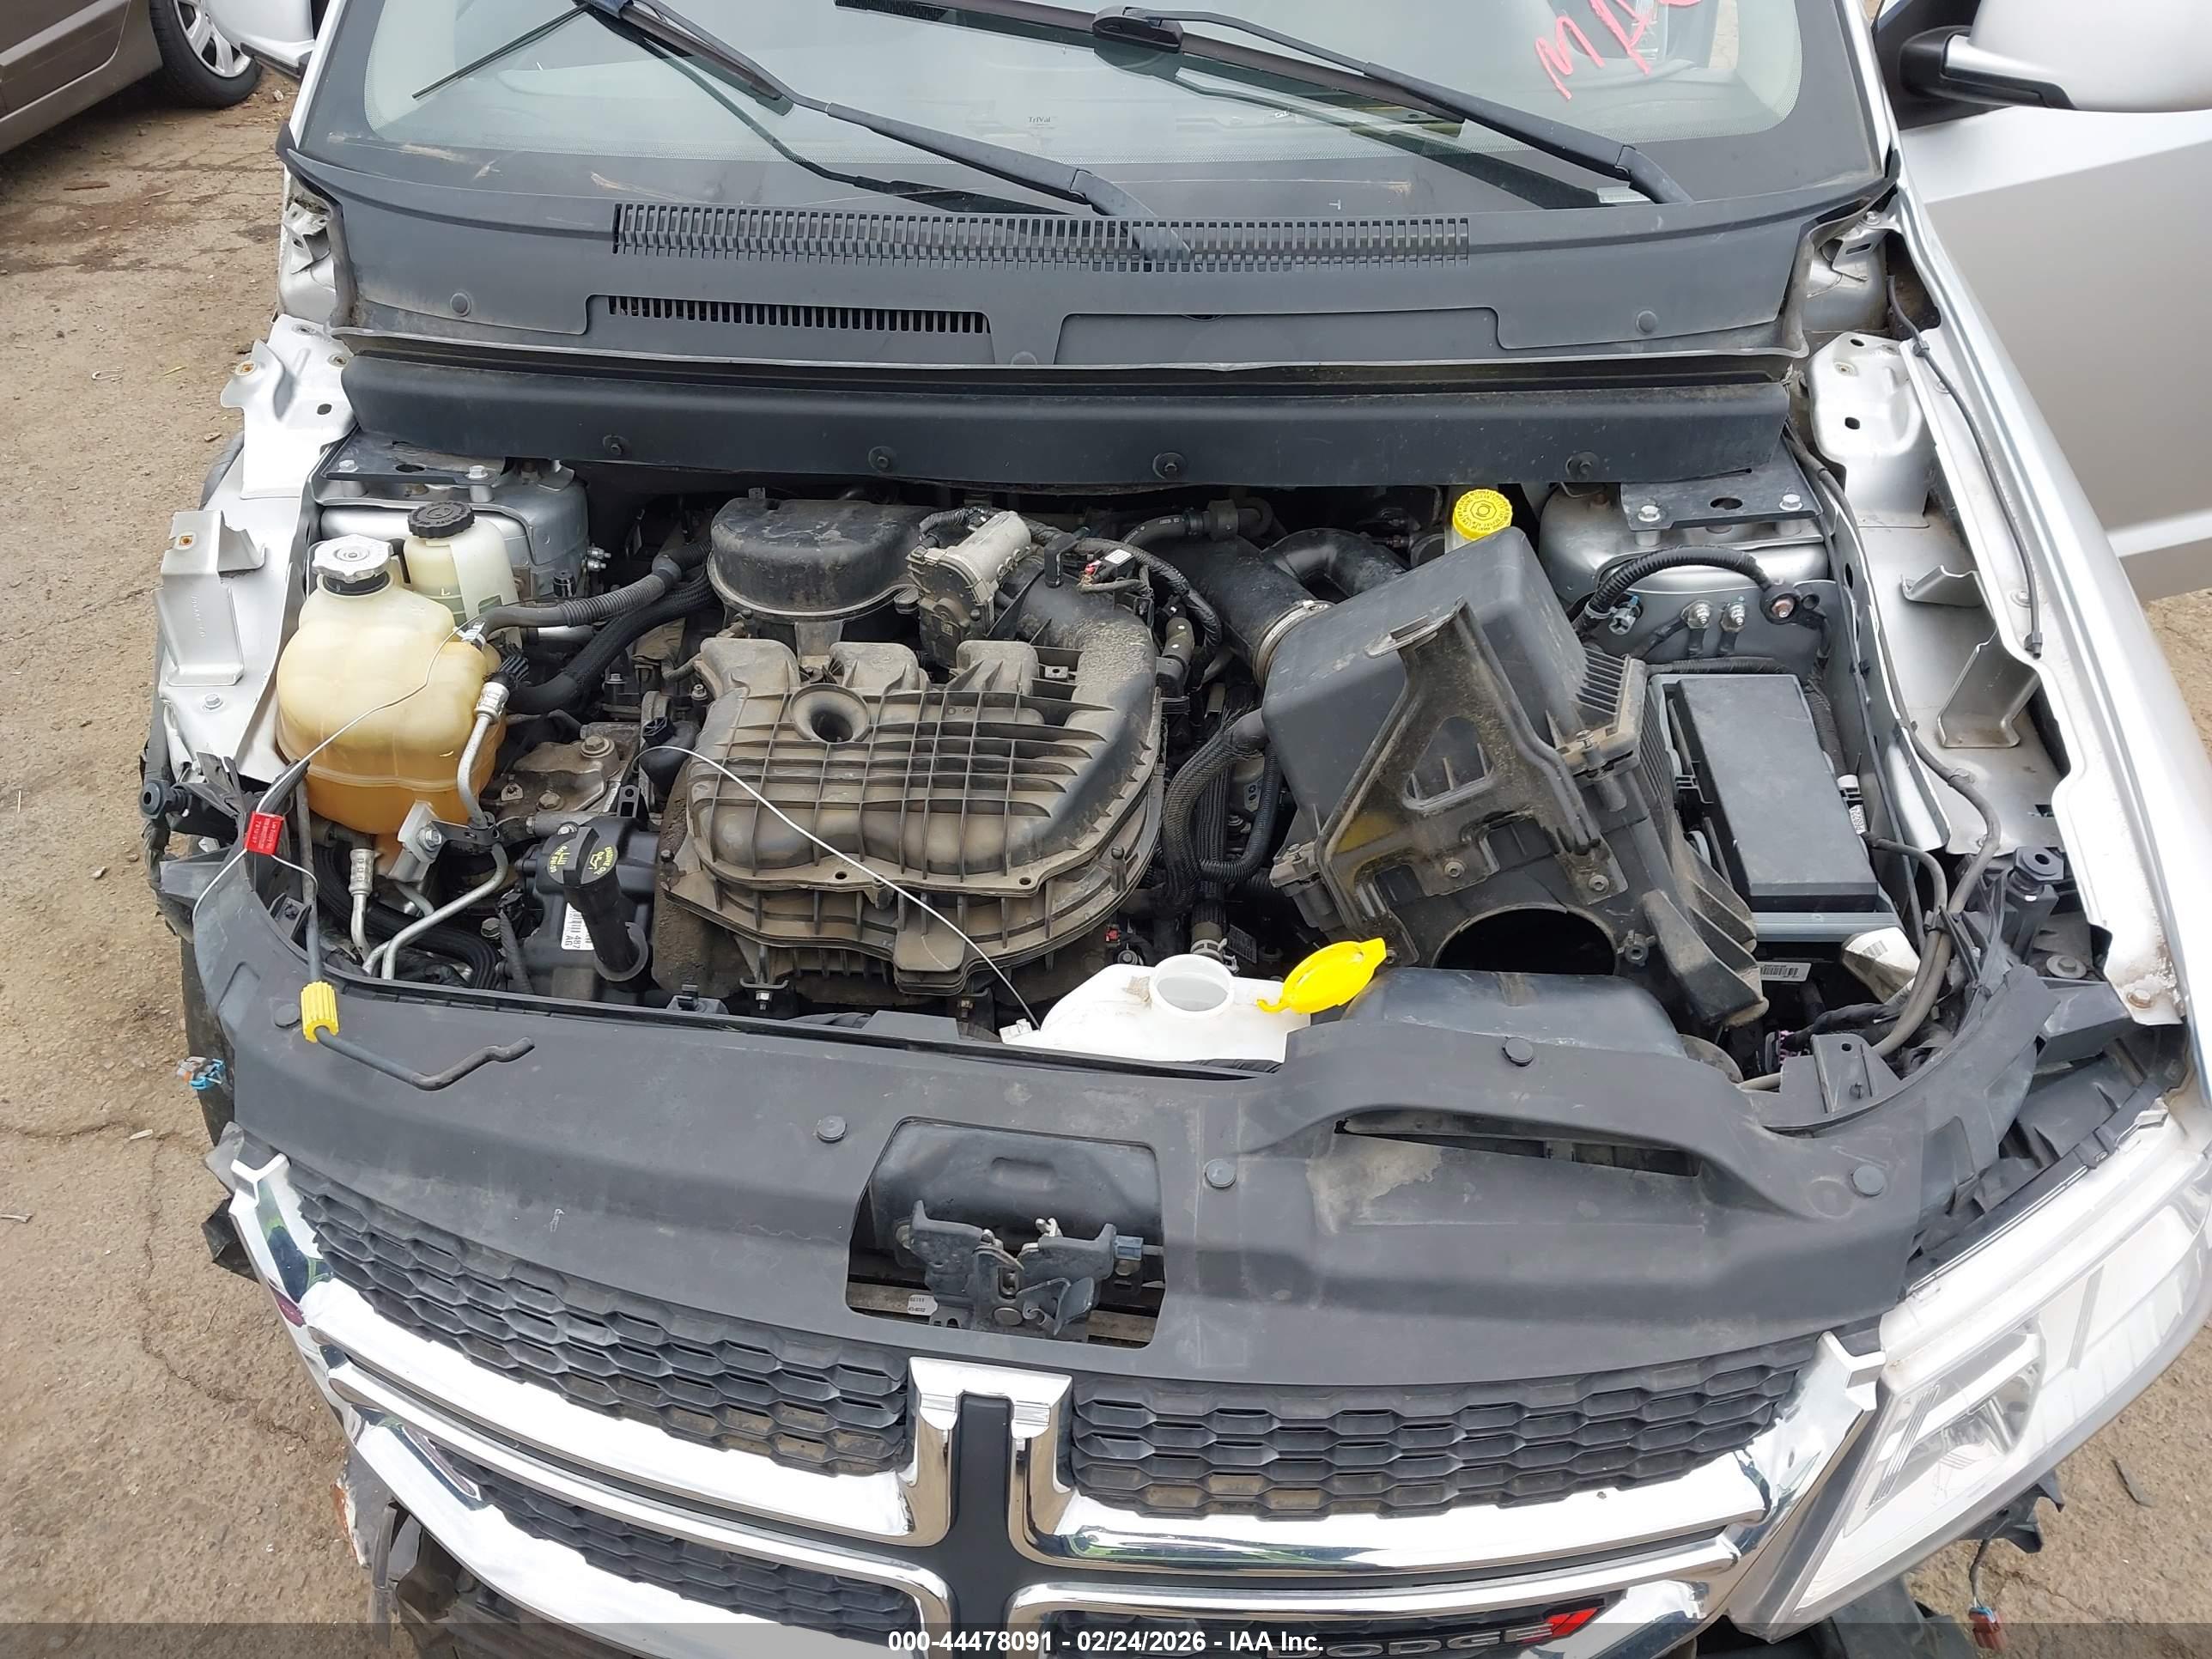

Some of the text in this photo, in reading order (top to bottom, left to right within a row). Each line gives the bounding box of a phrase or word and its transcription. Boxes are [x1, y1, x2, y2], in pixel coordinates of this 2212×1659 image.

[593, 846, 614, 875] ENGINE OIL
[1266, 1621, 1553, 1659] DODGE
